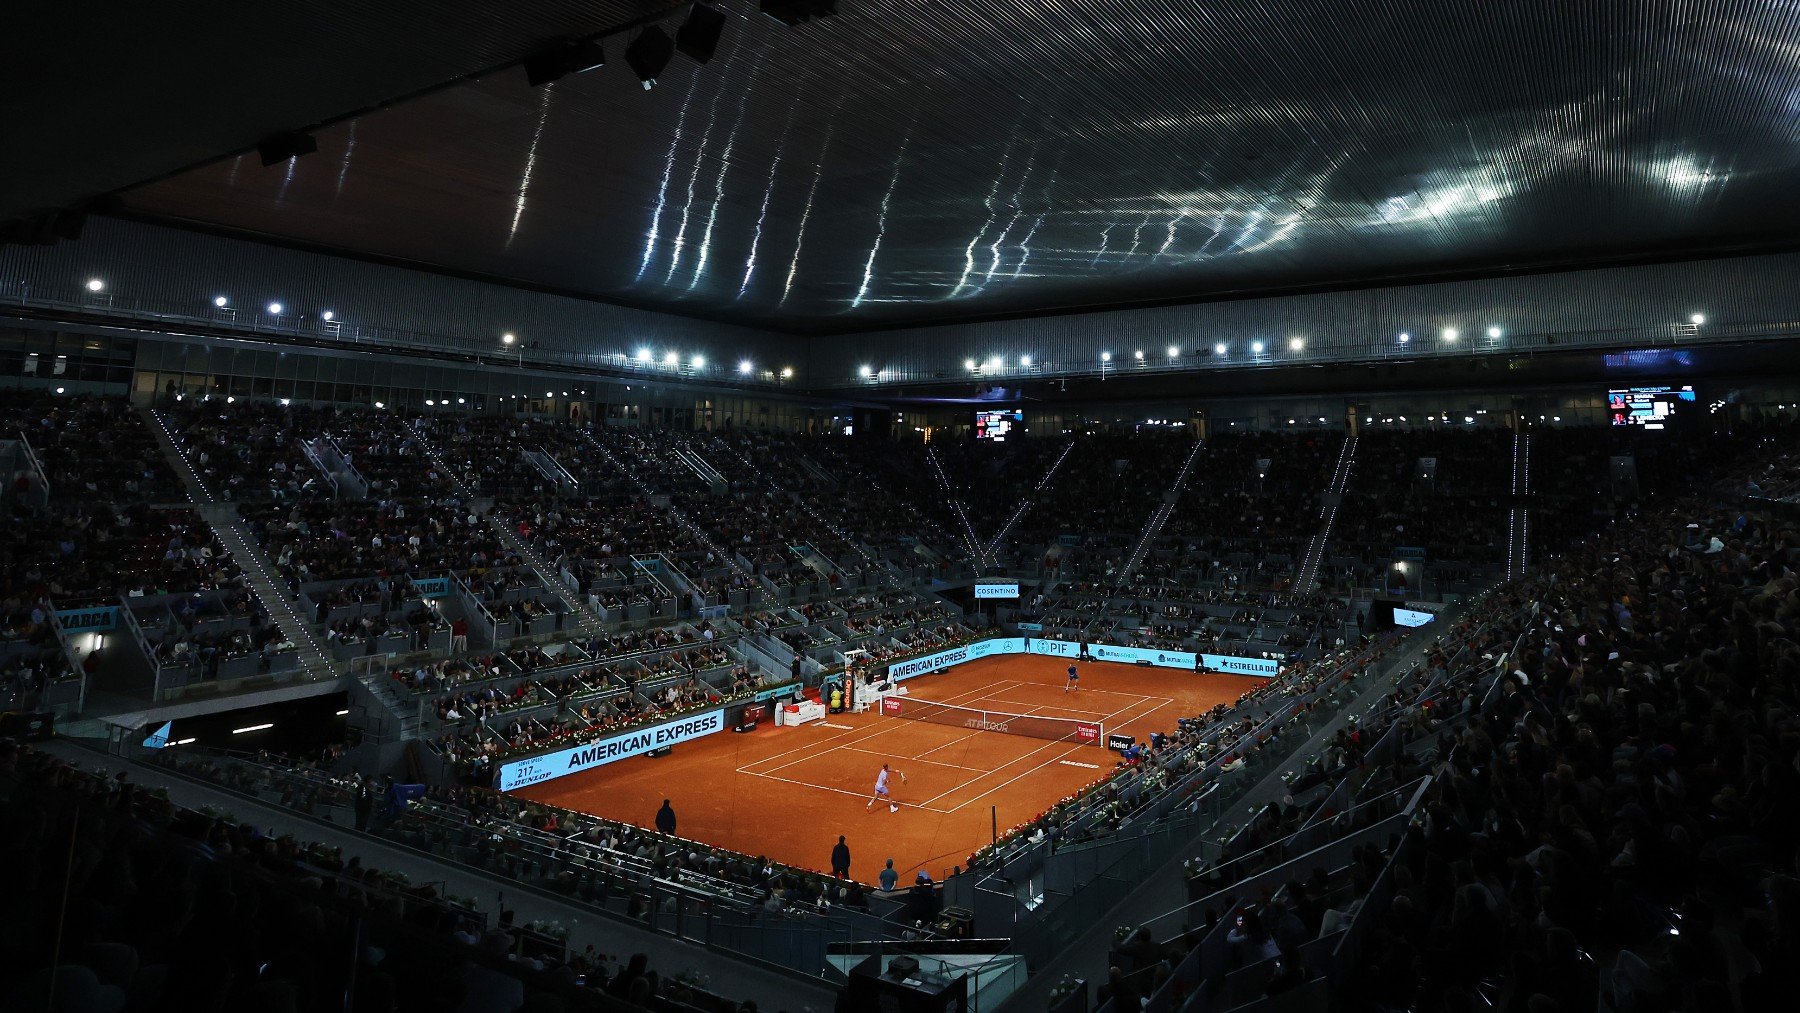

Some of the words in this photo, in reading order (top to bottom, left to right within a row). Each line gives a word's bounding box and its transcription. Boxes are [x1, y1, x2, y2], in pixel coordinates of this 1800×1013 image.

[1050, 643, 1067, 654] PIF
[892, 659, 933, 678] AMERICAN
[934, 650, 967, 667] EXPRESS
[1230, 662, 1264, 671] ESTRELLA
[985, 721, 1008, 732] TOUR
[568, 734, 652, 769] AMERICAN
[656, 715, 717, 744] EXPRESS
[1110, 740, 1129, 749] Haier
[518, 766, 534, 778] 217
[514, 772, 552, 786] DUNLOP
